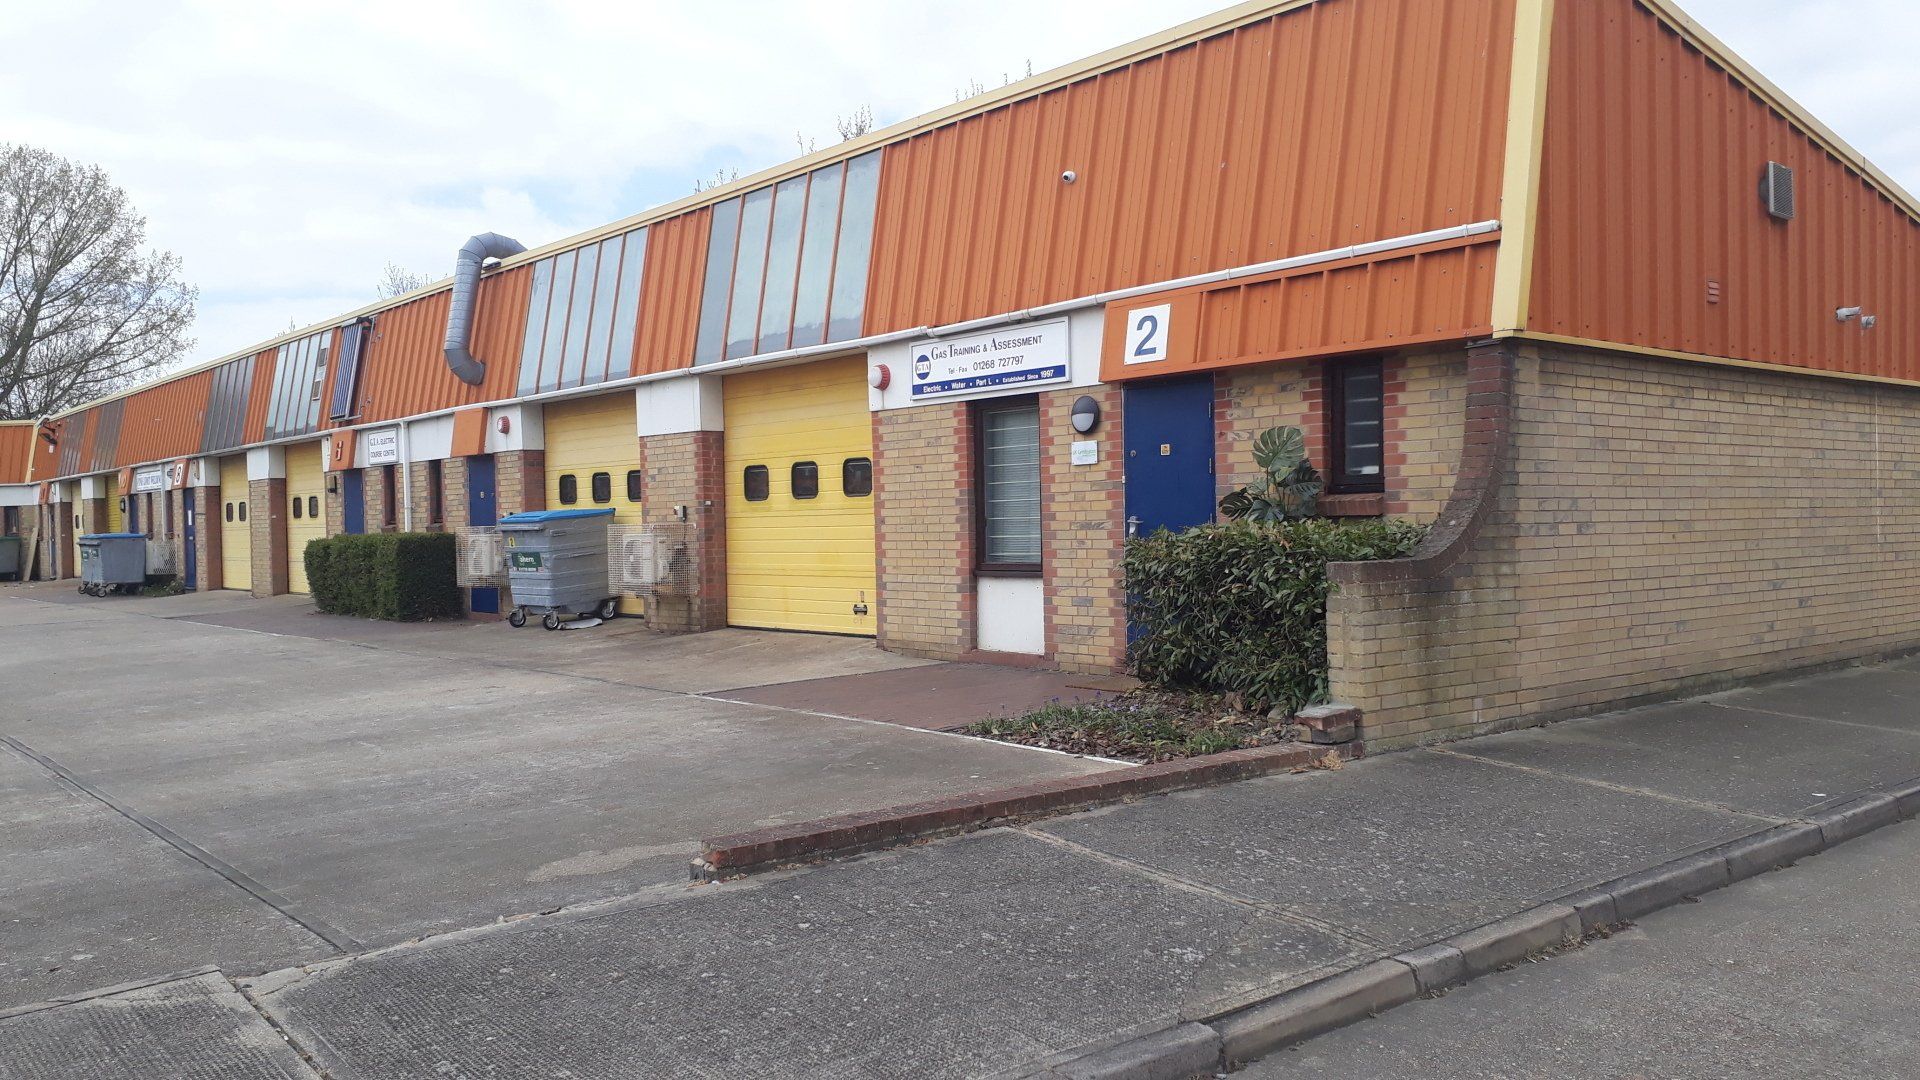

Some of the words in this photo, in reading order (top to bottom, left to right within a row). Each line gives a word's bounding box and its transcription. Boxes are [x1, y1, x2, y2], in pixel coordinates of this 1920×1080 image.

[1134, 315, 1157, 356] 2
[948, 344, 981, 358] TRAINING
[982, 343, 988, 352] &
[989, 334, 1043, 352] ASSESSMENT
[916, 362, 930, 372] GTA
[973, 359, 995, 371] 01268
[998, 355, 1024, 367] 727797
[922, 385, 942, 393] Electric
[951, 381, 966, 389] Water
[976, 379, 987, 387] Part
[1002, 375, 1026, 383] Established
[1027, 373, 1039, 381] Since
[1040, 369, 1054, 378] 1997
[175, 466, 182, 483] 8
